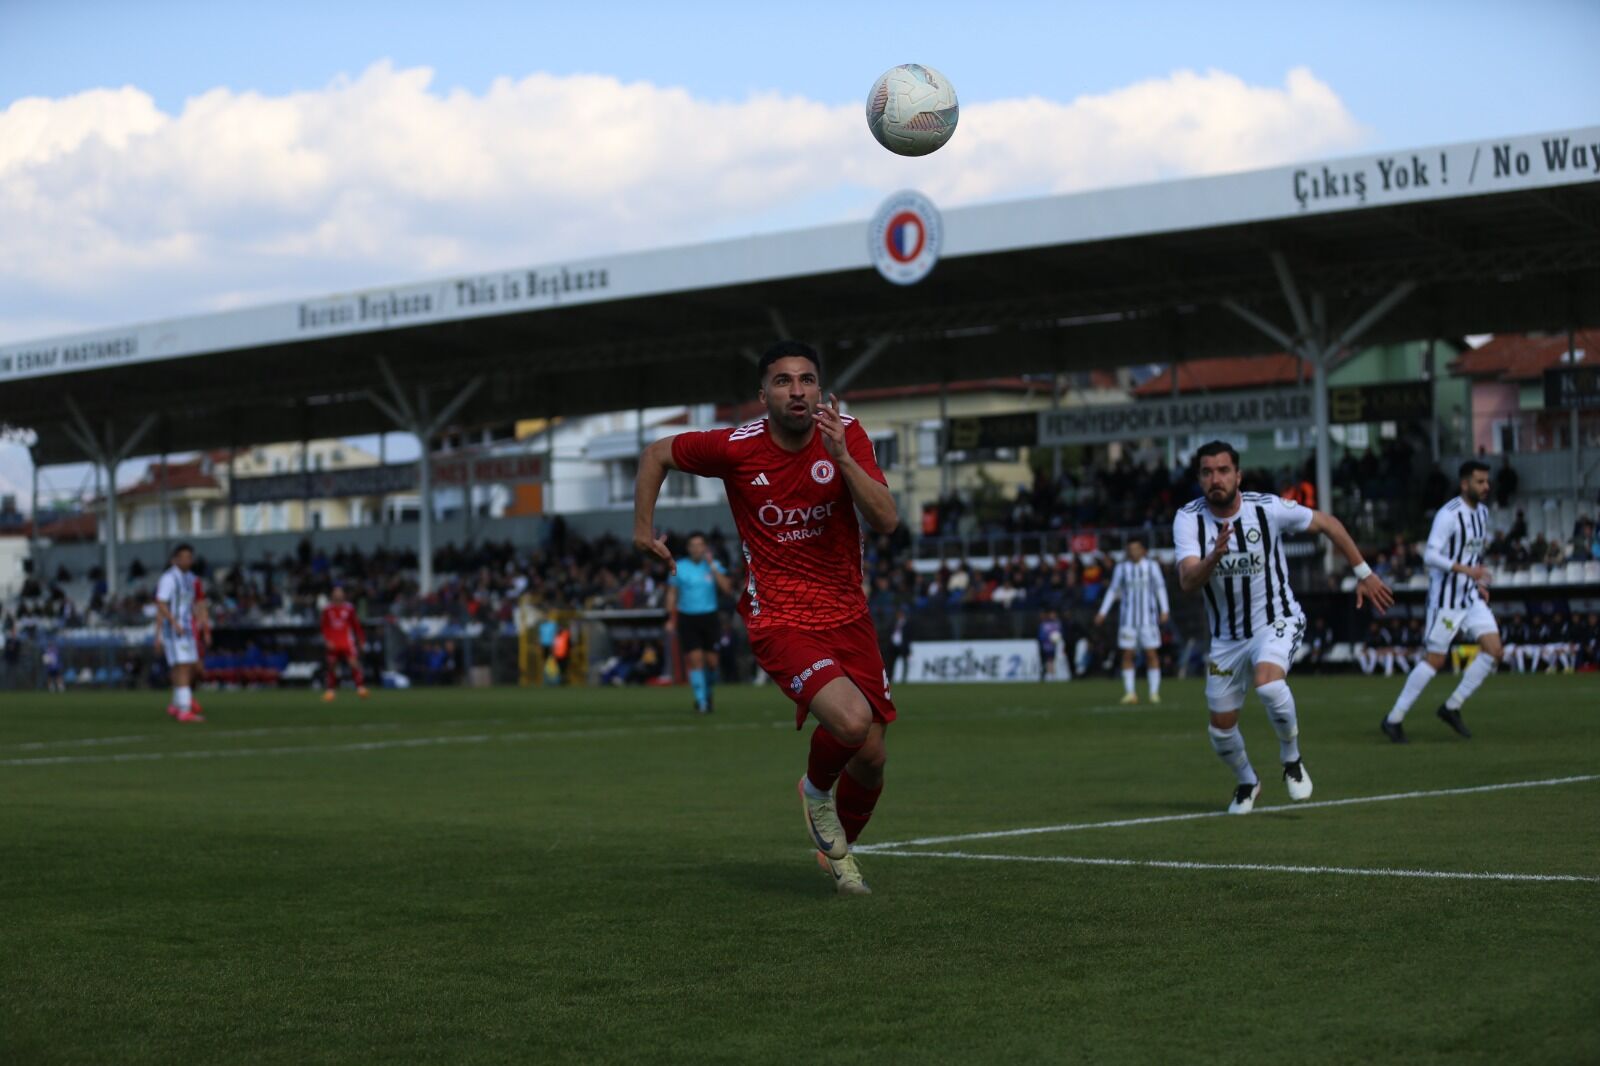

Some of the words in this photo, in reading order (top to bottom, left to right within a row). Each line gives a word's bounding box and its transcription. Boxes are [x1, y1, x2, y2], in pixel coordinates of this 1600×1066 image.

[1293, 167, 1368, 208] Çıkış
[1377, 155, 1429, 191] Yok
[1492, 144, 1530, 178] No
[455, 276, 496, 306] This
[502, 273, 520, 300] is
[17, 346, 58, 372] ESNAF
[758, 499, 835, 527] Özyer
[777, 525, 825, 543] SARRAF
